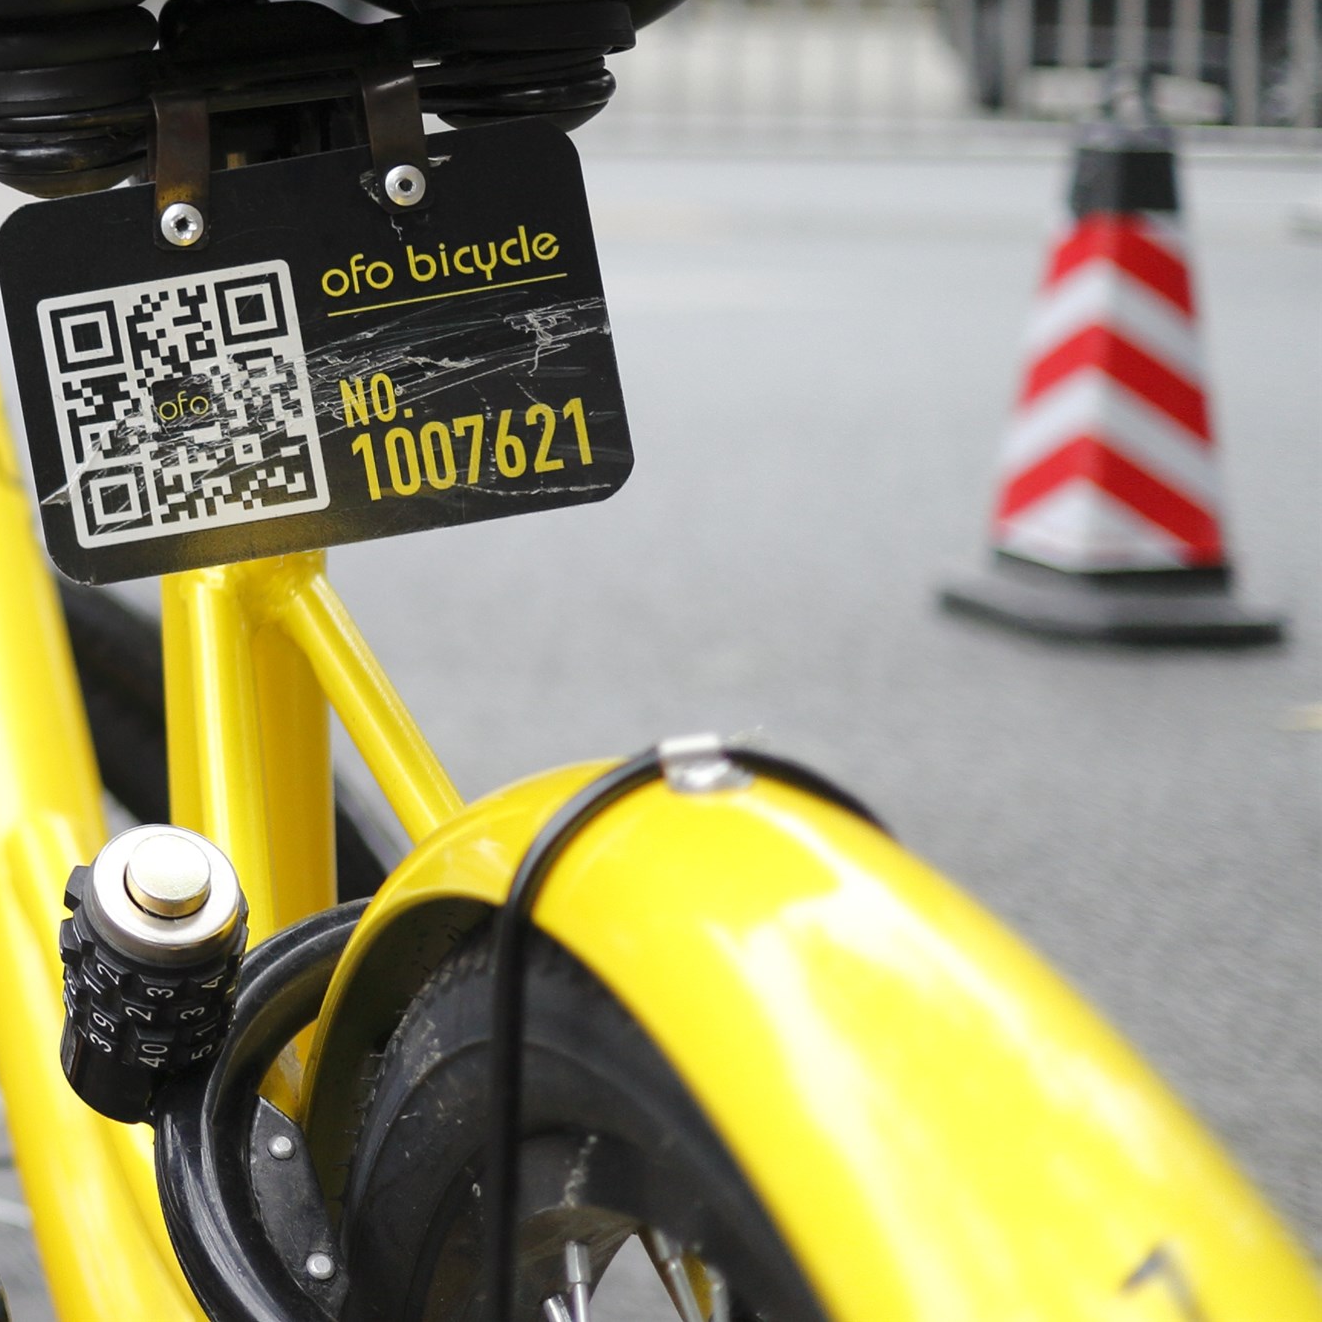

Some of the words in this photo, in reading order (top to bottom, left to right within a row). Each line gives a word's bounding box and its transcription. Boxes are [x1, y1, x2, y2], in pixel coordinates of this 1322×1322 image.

[321, 253, 394, 297] ofo
[406, 225, 560, 283] bicycle
[158, 390, 209, 420] ofo
[351, 397, 594, 501] 1007621
